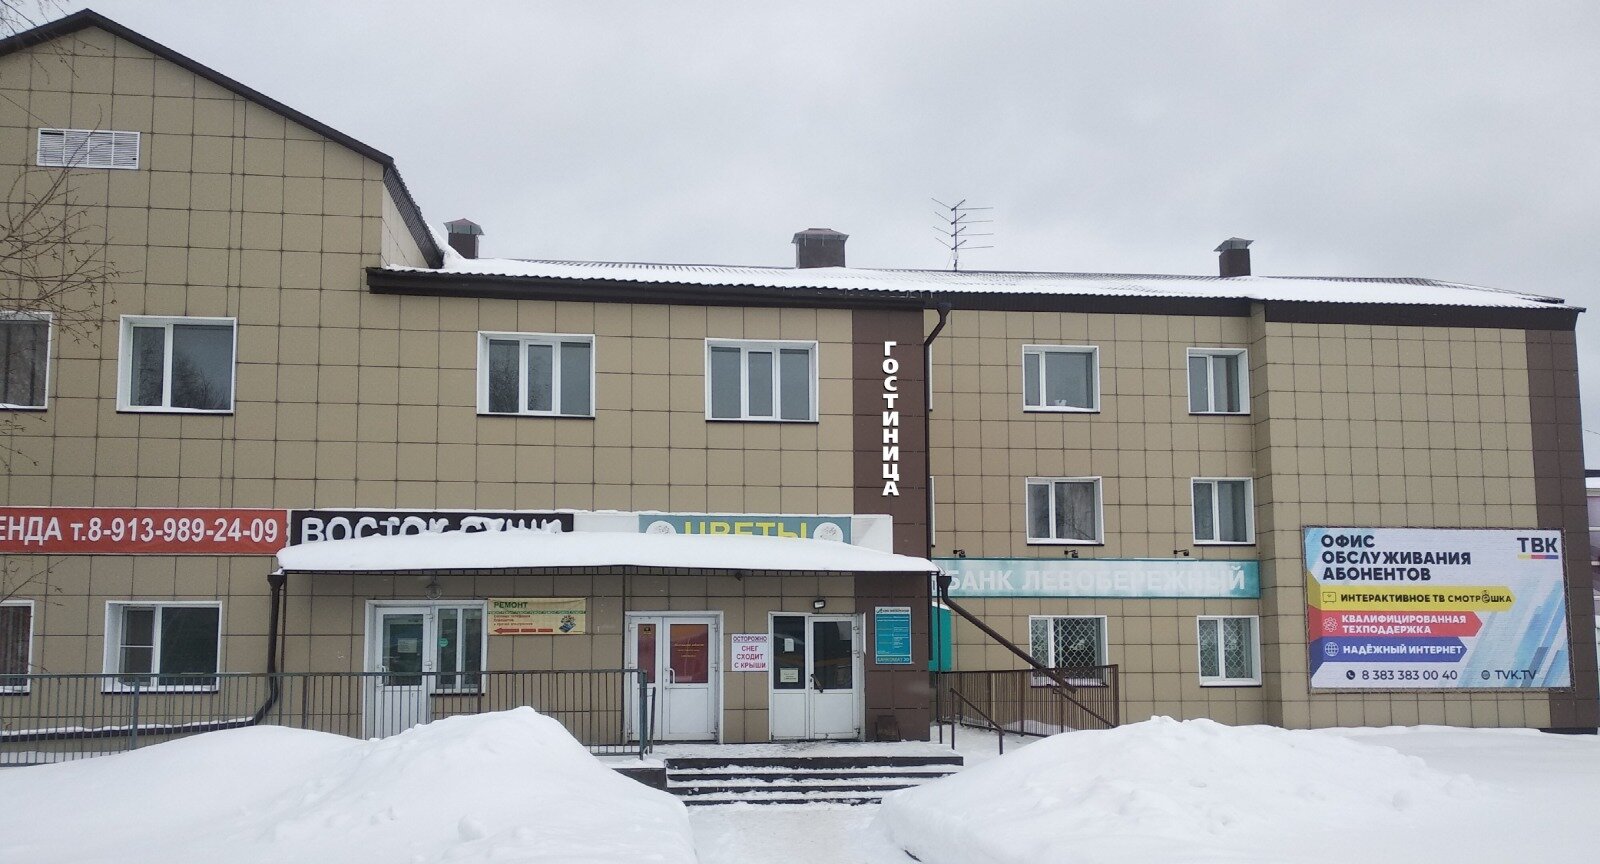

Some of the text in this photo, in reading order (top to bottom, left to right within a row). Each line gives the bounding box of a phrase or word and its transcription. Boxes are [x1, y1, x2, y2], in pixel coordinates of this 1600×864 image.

[882, 341, 900, 496] ГОСТИНИЦА
[70, 517, 278, 542] т.8-913-989-24-09
[1321, 535, 1558, 553] ОФИС ТВК
[1322, 551, 1471, 566] ОБСЛУЖИВАНИЯ
[948, 566, 1245, 591] БАНК ЛЕВОБЕРЕЖНЫЙ
[1323, 567, 1431, 581] АБОНЕНТОВ
[1341, 594, 1430, 603] ИНТЕРАКТИВНОЕ
[1433, 594, 1445, 603] ТВ
[1342, 615, 1467, 624] КВАЛИФИЦИРОВАННАЯ
[1342, 625, 1431, 634] ТЕХПОДДЕРЖКА
[1343, 644, 1463, 655] НАДЁЖНЫЙ ИНТЕРНЕТ
[1362, 670, 1458, 680] 8 383 383 00 40
[1495, 670, 1537, 680] TVK.TV
